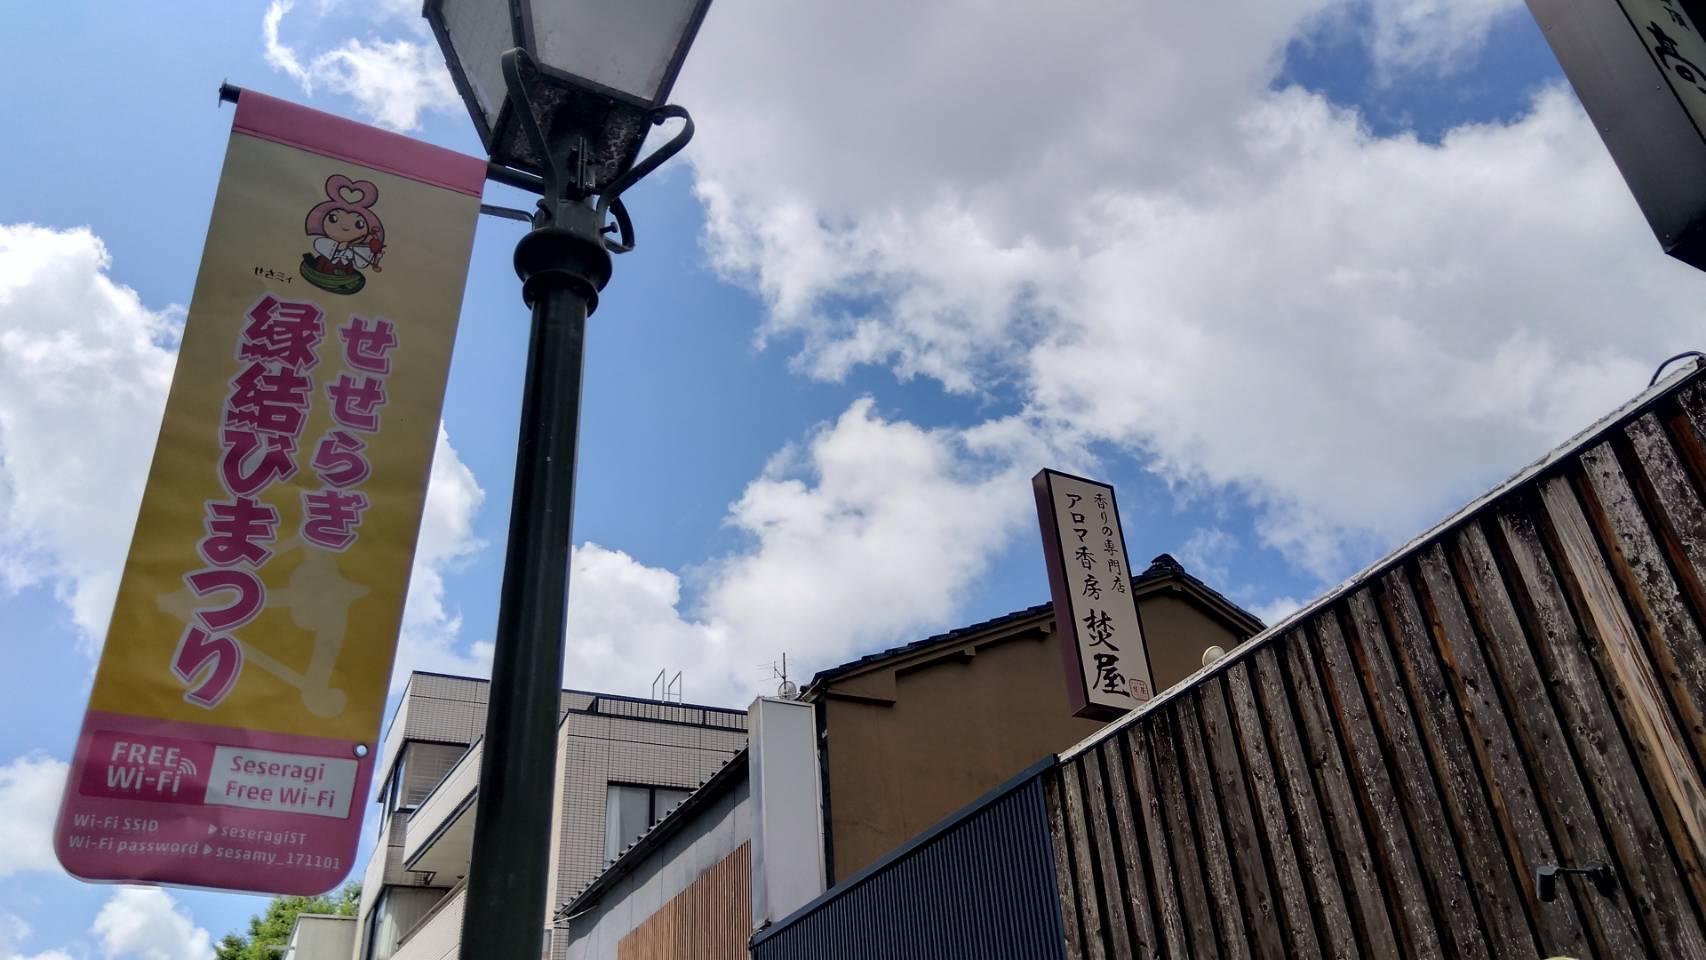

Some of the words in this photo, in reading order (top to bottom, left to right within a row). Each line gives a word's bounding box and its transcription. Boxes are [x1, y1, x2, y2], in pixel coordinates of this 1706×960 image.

[303, 317, 398, 550] せせらぎ
[173, 295, 324, 706] 縁結びまつり
[1066, 493, 1102, 601] アロマ香房
[1094, 493, 1126, 594] 香りの専門店
[1082, 608, 1131, 698] 焚屋
[111, 741, 181, 769] FREE
[230, 755, 325, 782] Seseragi
[106, 765, 181, 794] Wi-Fi
[225, 780, 274, 803] Free
[279, 789, 336, 808] Wi-Fi
[73, 813, 119, 830] Wi-Fi
[122, 817, 160, 832] SSID
[68, 835, 115, 849] Wi-Fi
[116, 840, 199, 856] password
